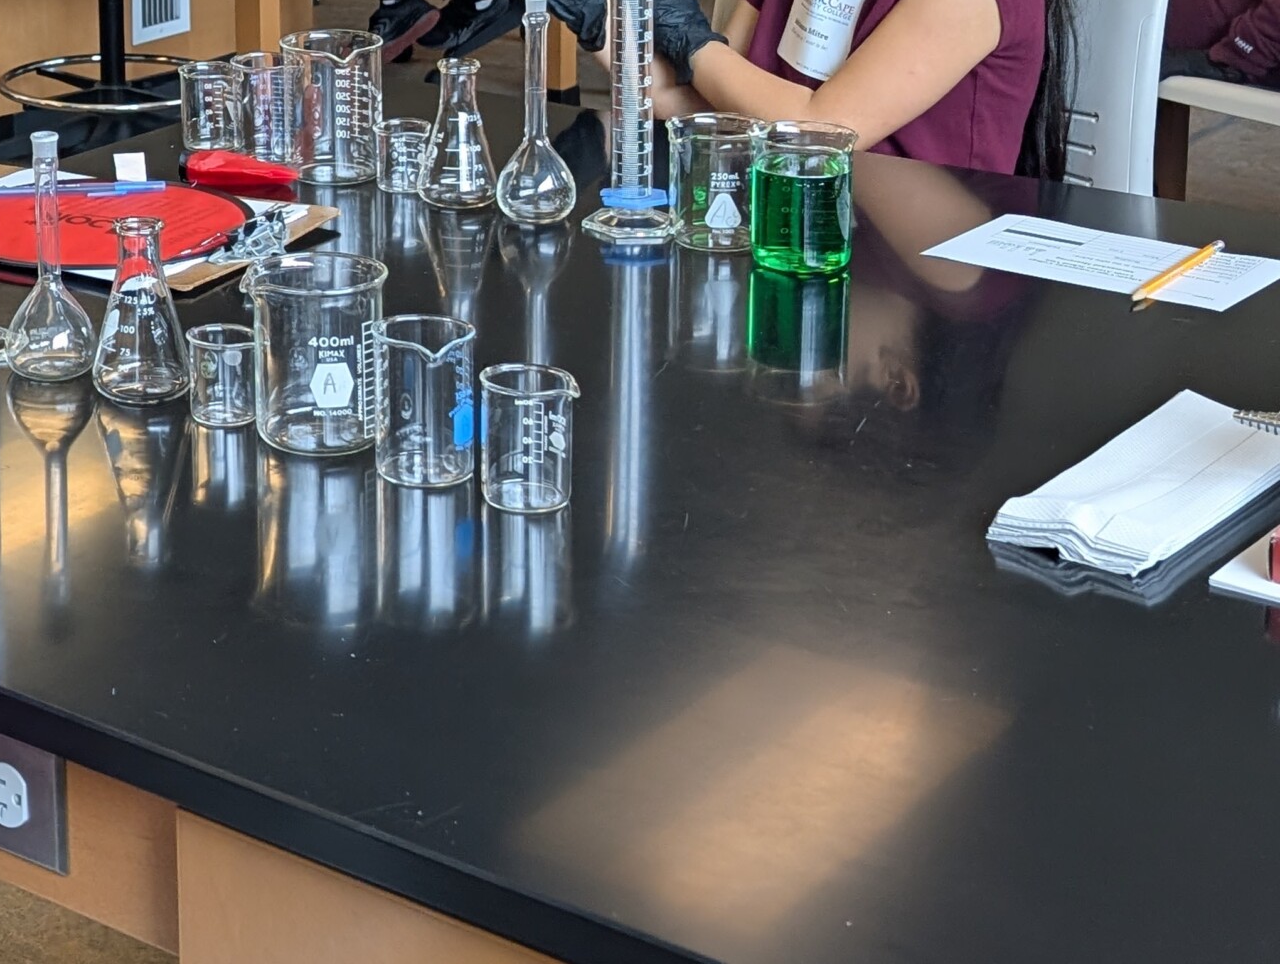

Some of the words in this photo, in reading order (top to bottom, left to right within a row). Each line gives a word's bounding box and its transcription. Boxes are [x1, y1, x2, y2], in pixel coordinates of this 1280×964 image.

[808, 28, 829, 41] Mitre
[710, 172, 740, 180] 250mL
[476, 178, 485, 186] 50
[124, 296, 138, 304] 125
[120, 324, 135, 334] 100
[308, 335, 354, 348] 400ml
[120, 348, 130, 356] 75
[318, 350, 345, 359] KIMAX
[324, 372, 336, 395] A
[329, 408, 352, 416] 14000
